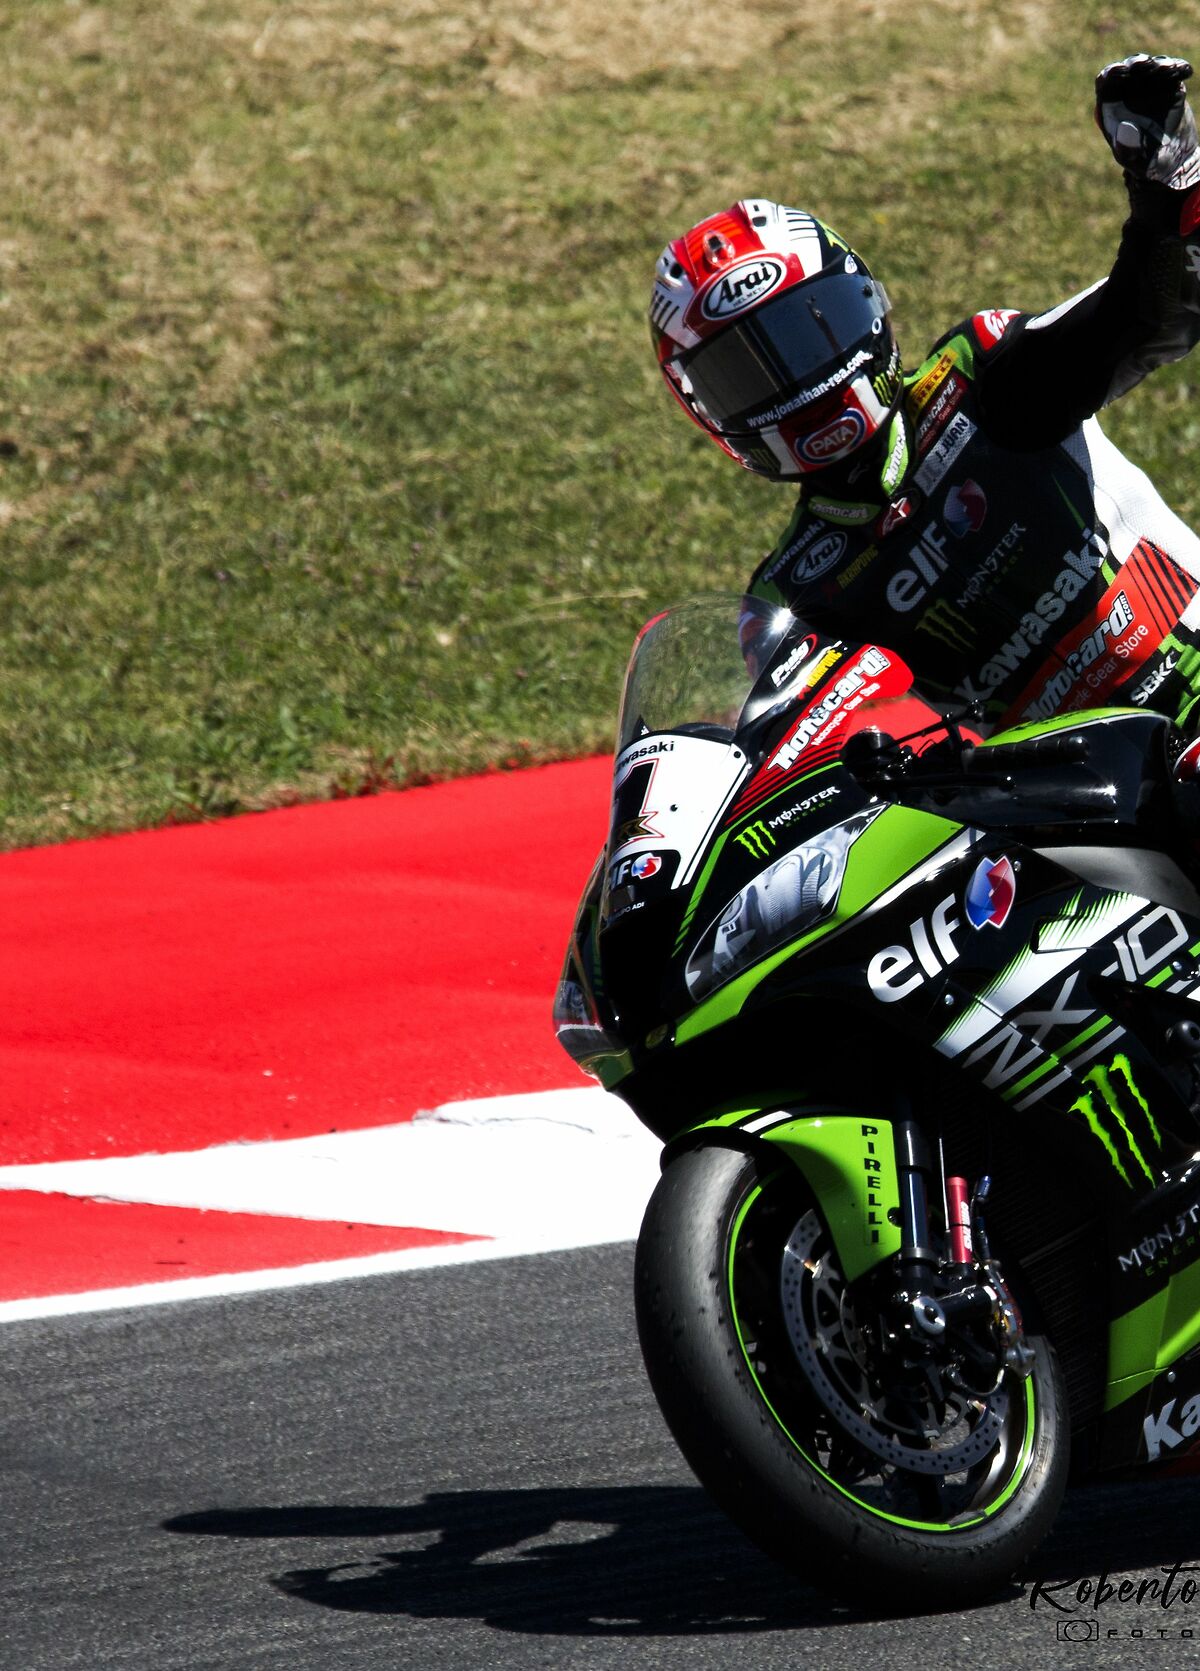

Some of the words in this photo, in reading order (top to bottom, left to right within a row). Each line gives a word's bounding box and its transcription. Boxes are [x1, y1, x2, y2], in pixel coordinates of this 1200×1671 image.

[710, 262, 773, 313] Arai
[810, 424, 855, 455] PATA
[886, 520, 949, 613] elf
[952, 528, 1108, 702] Kawasaki
[1086, 656, 1120, 688] Gear
[1114, 624, 1149, 660] Store
[768, 786, 841, 829] MONSTER
[867, 892, 960, 1003] elf
[861, 1124, 883, 1243] PIRELLI
